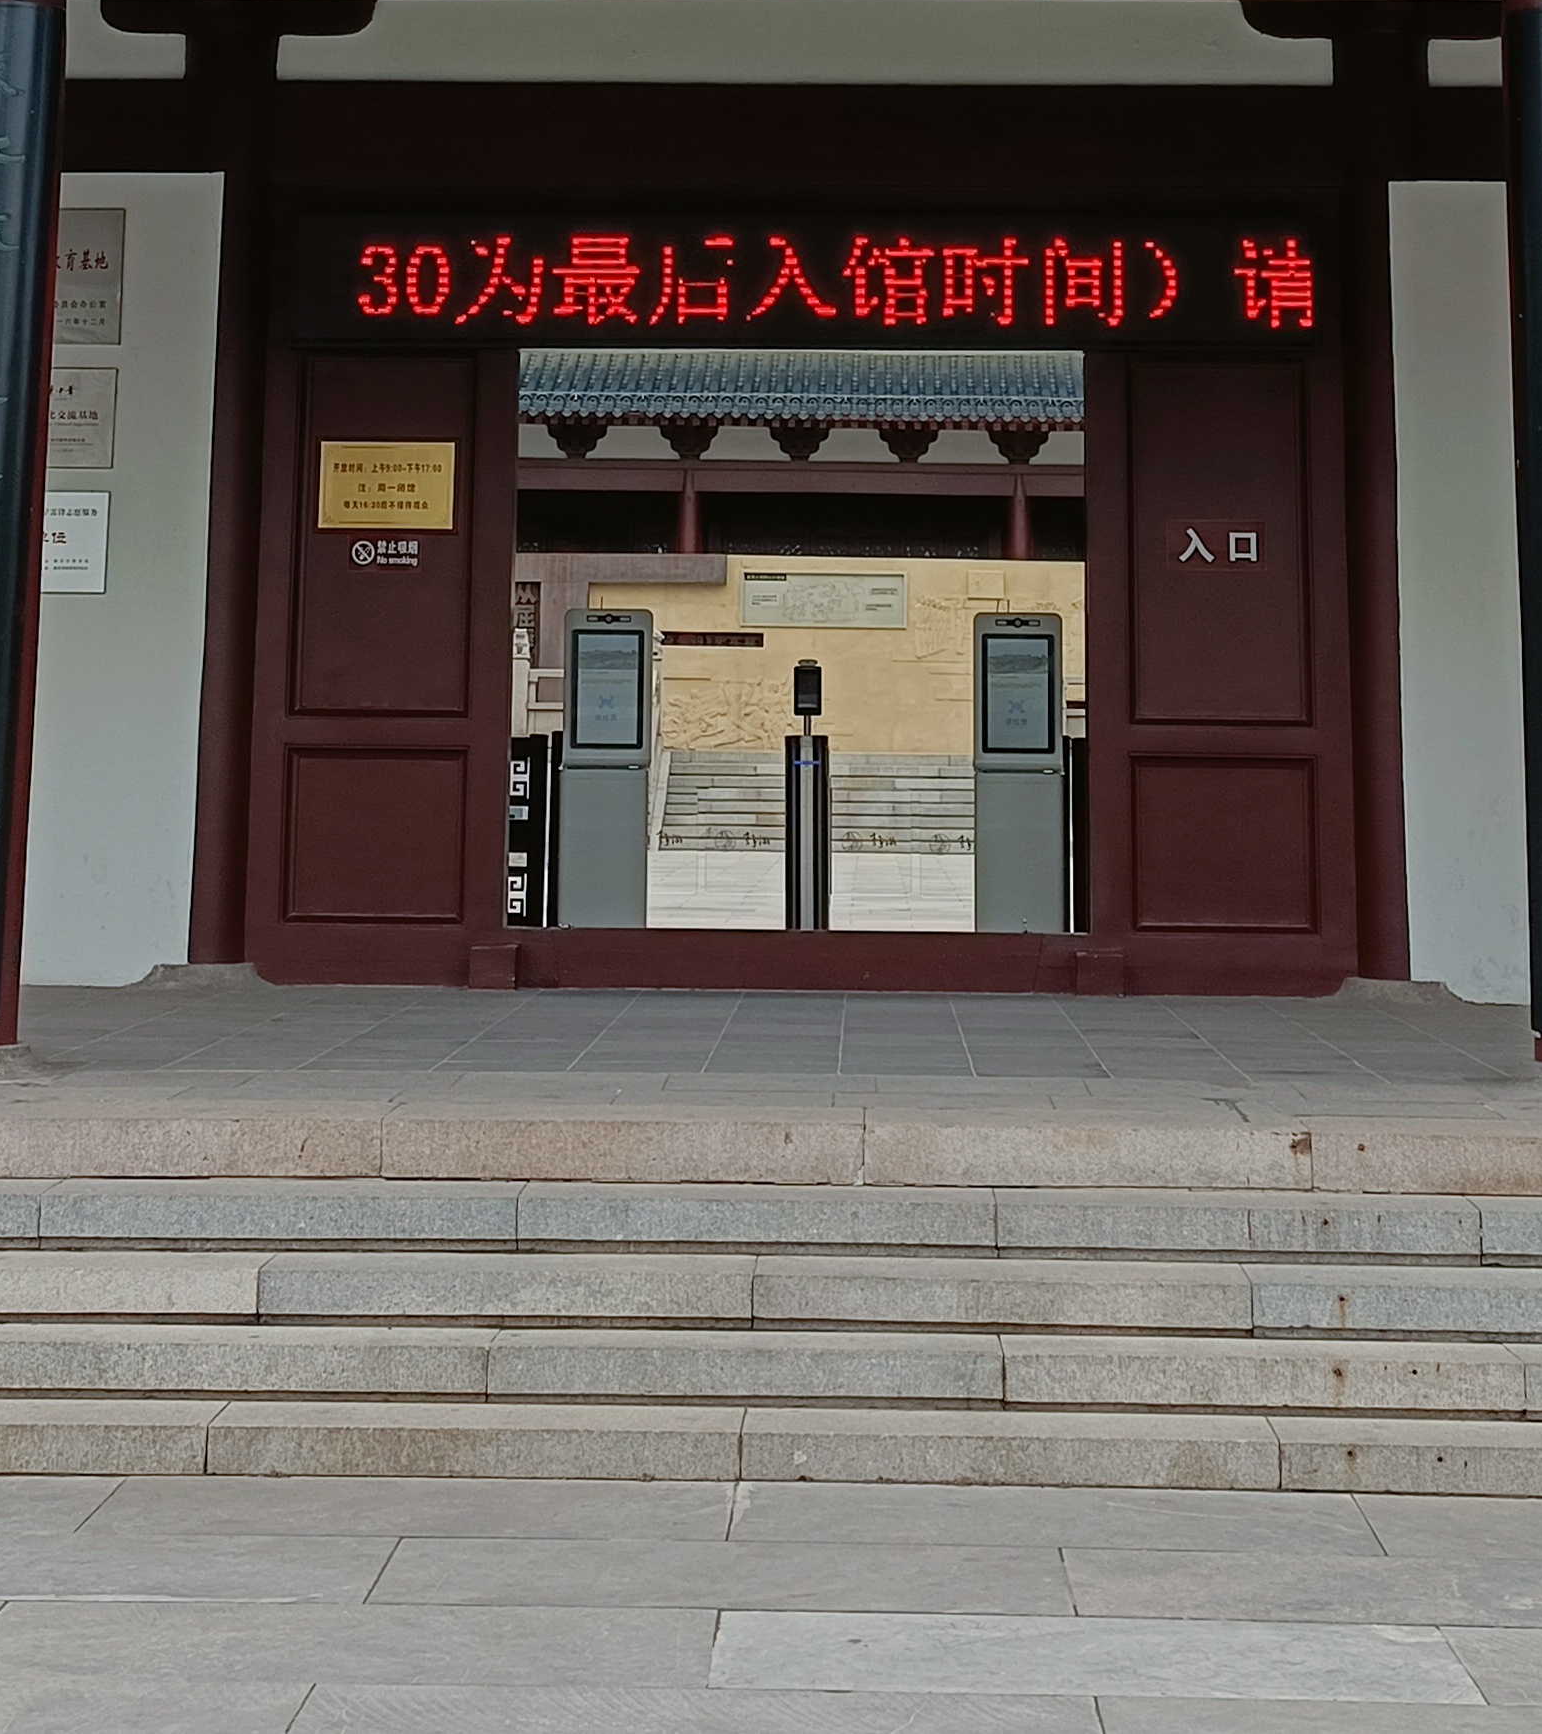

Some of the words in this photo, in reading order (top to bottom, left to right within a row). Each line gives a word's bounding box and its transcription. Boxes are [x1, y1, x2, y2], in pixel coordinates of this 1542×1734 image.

[376, 540, 419, 555] 禁止吸烟
[1178, 527, 1258, 563] 入口
[376, 555, 387, 564] No
[388, 555, 418, 567] smoking
